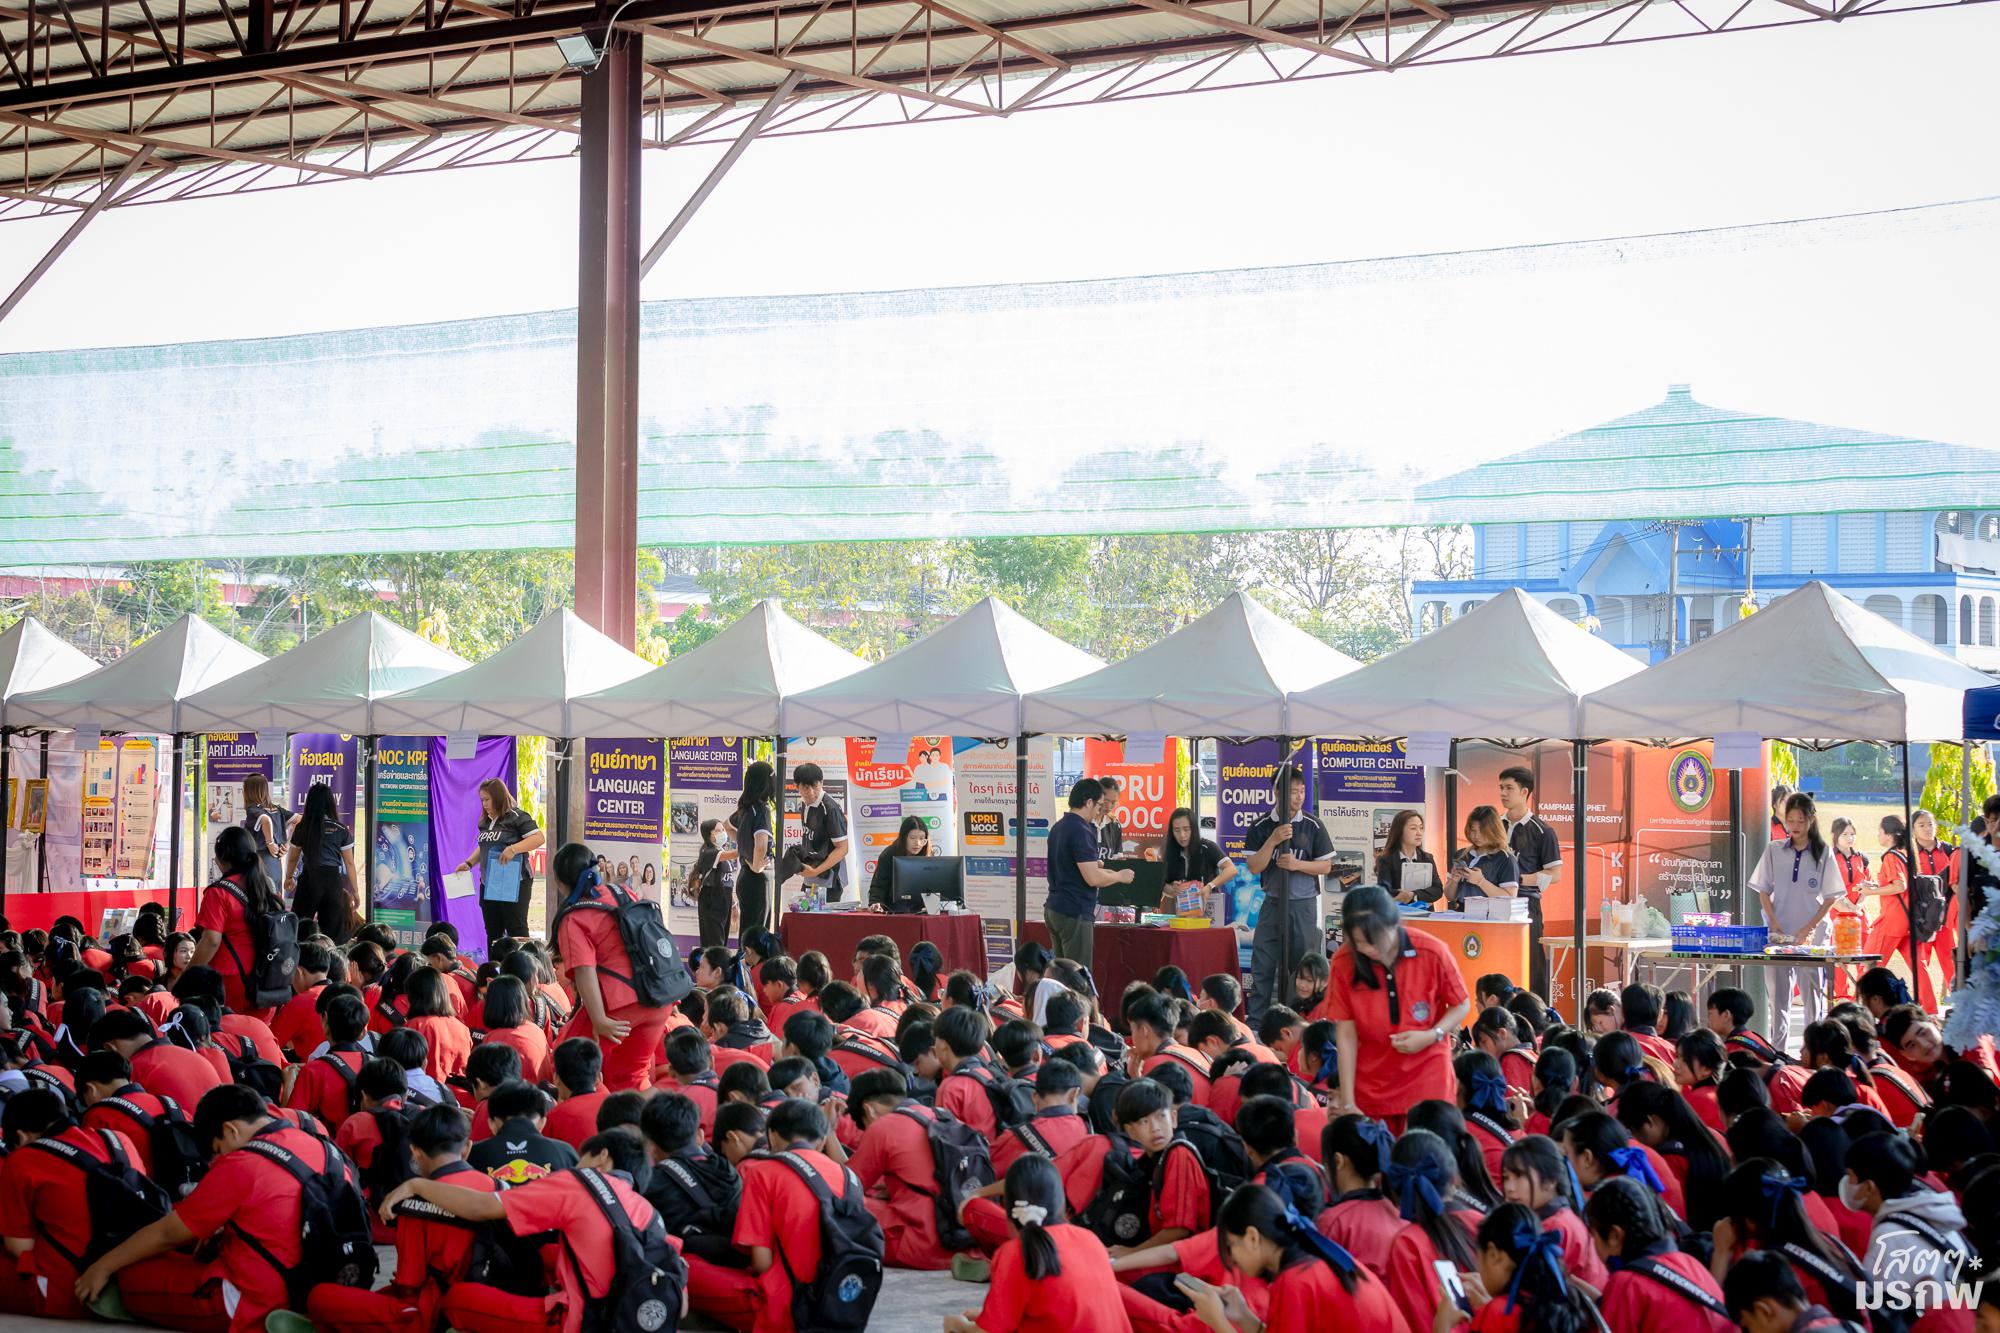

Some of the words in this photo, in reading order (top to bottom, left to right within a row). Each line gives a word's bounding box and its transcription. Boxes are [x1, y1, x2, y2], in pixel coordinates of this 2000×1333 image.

[208, 733, 238, 745] หองสมุด
[670, 736, 709, 750] ศูนยภาษา
[208, 745, 228, 757] ARIT
[230, 745, 266, 757] LIBRA
[378, 750, 404, 765] NOC
[407, 750, 428, 766] KPR
[670, 750, 709, 760] LANGUAGE
[710, 752, 738, 762] CENTER
[300, 748, 344, 770] ห้องสมุด
[590, 748, 656, 774] ศูนย์ภาษา
[1322, 757, 1376, 768] COMPUTER
[1378, 758, 1418, 770] CENT
[856, 766, 904, 782] นักเรียน
[589, 778, 656, 795] LANGUAGE
[968, 782, 994, 796] ใครๆ
[1093, 775, 1164, 802] PRU
[704, 794, 738, 804] การให้บริการ
[1222, 789, 1276, 804] COMPU
[598, 800, 645, 815] CENTER
[1323, 806, 1369, 818] การให้บริการ
[1538, 802, 1574, 812] KAMPHAE
[970, 814, 998, 823] KPRU
[1114, 806, 1164, 830] OOC
[1233, 812, 1266, 827] CEN
[1538, 814, 1575, 823] RAJABHA
[1584, 815, 1623, 824] NIVERSITY
[971, 823, 998, 832] MOOC
